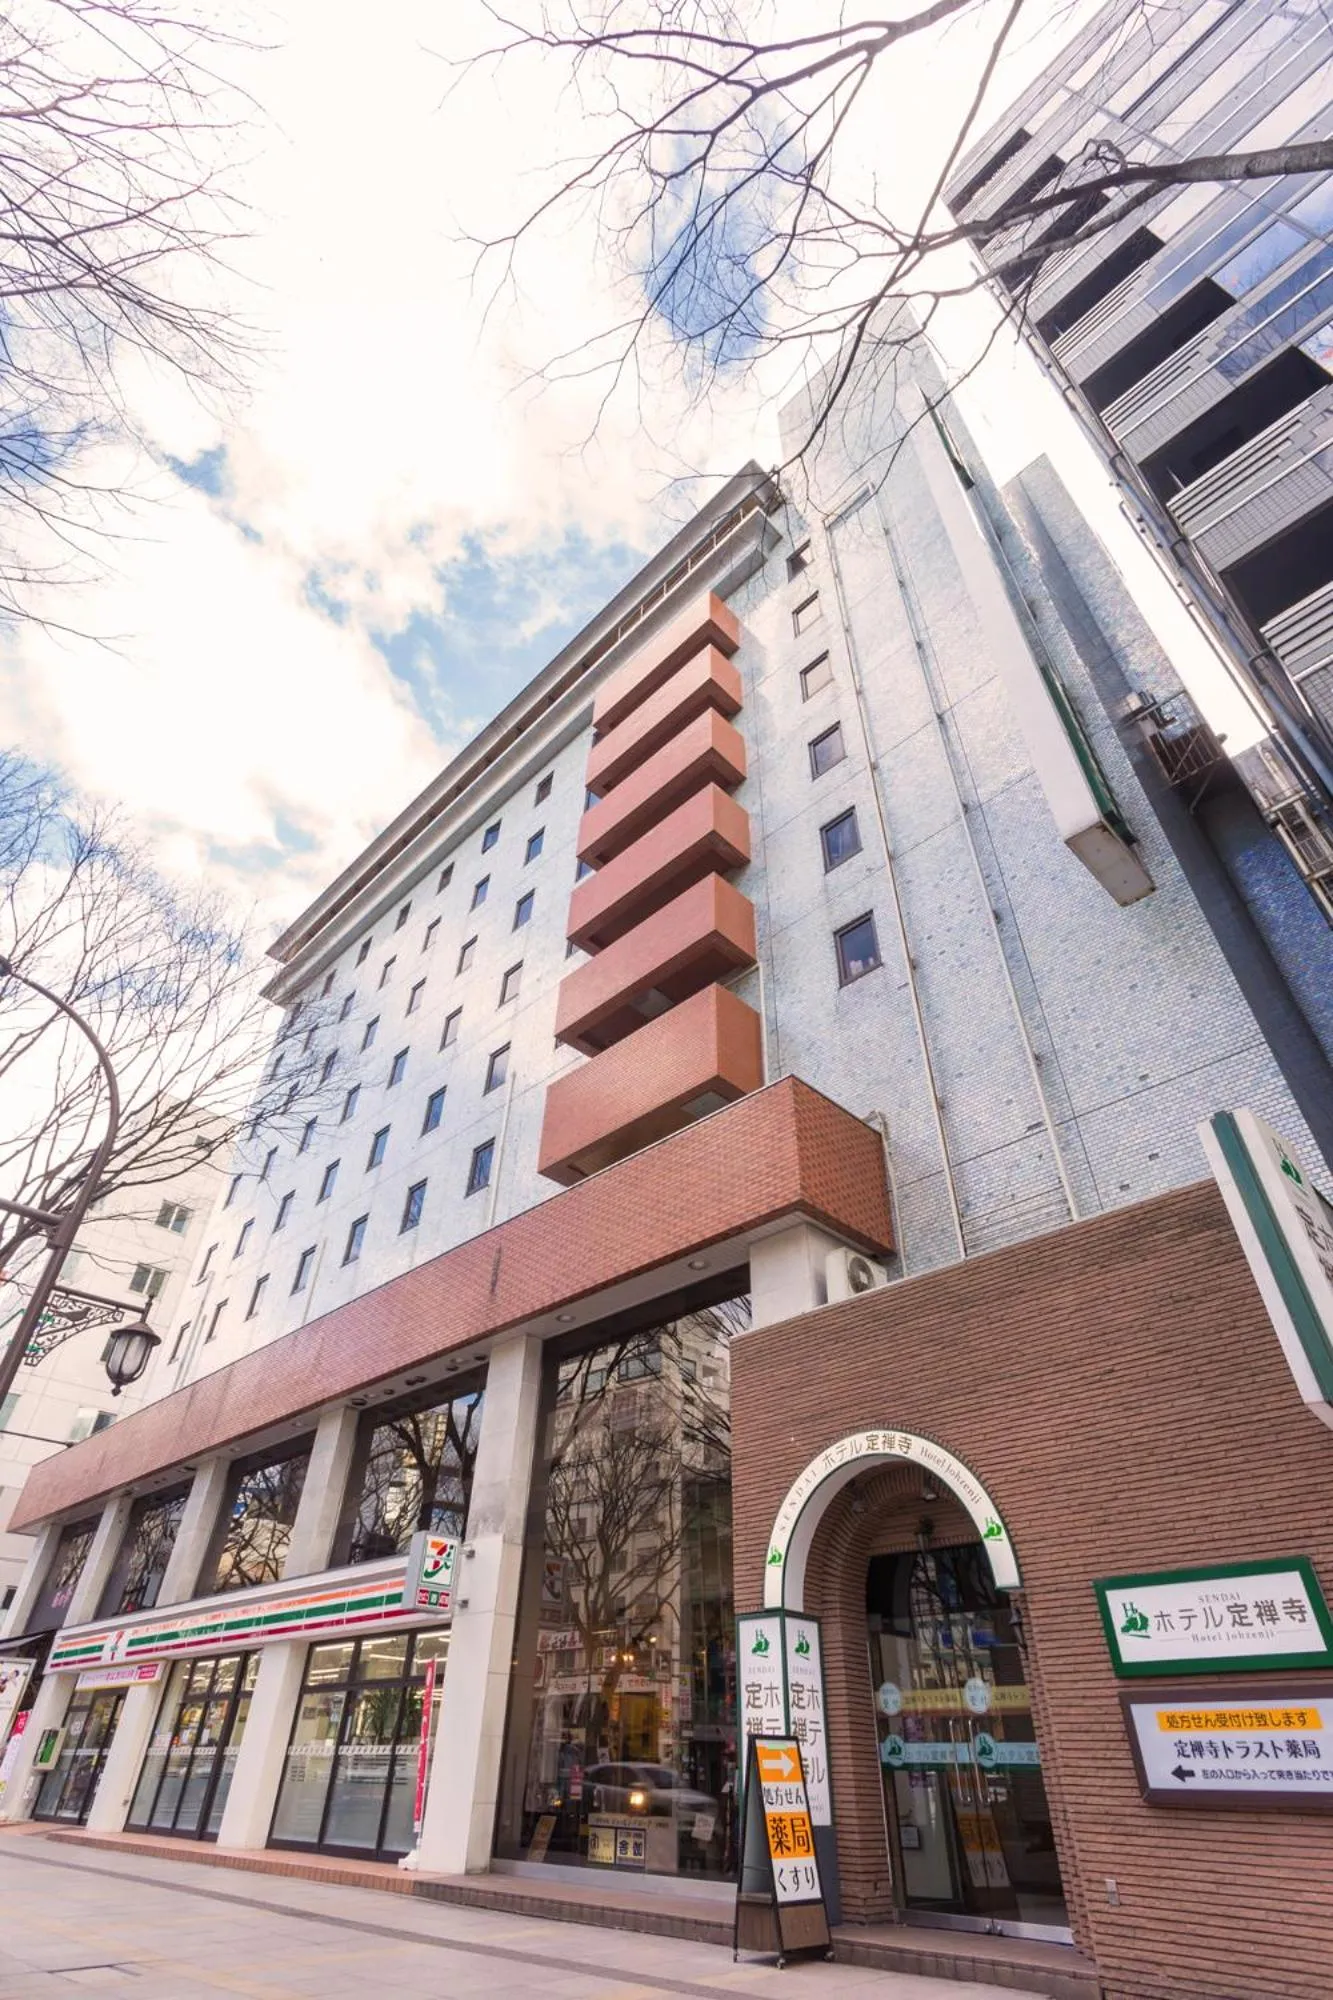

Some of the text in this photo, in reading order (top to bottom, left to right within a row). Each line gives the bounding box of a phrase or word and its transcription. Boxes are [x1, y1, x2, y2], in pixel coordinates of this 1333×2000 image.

[822, 1432, 914, 1468] ホテル定禅寺
[920, 1446, 946, 1470] Hotel
[779, 1470, 818, 1532] SENDAI
[1198, 1592, 1241, 1603] SENDAI
[1153, 1597, 1308, 1633] ホテル定禅寺
[1192, 1631, 1222, 1643] Hotel
[1166, 1711, 1308, 1730] 処方せん受付け致します
[806, 1683, 825, 1786] ホテル
[1173, 1738, 1321, 1760] 定禅寺トラスト薬局
[1201, 1768, 1333, 1781] 左の入口から入って突き当たりで
[763, 1785, 804, 1807] 処方せん
[768, 1815, 811, 1856] 薬局
[777, 1865, 817, 1893] くすり
